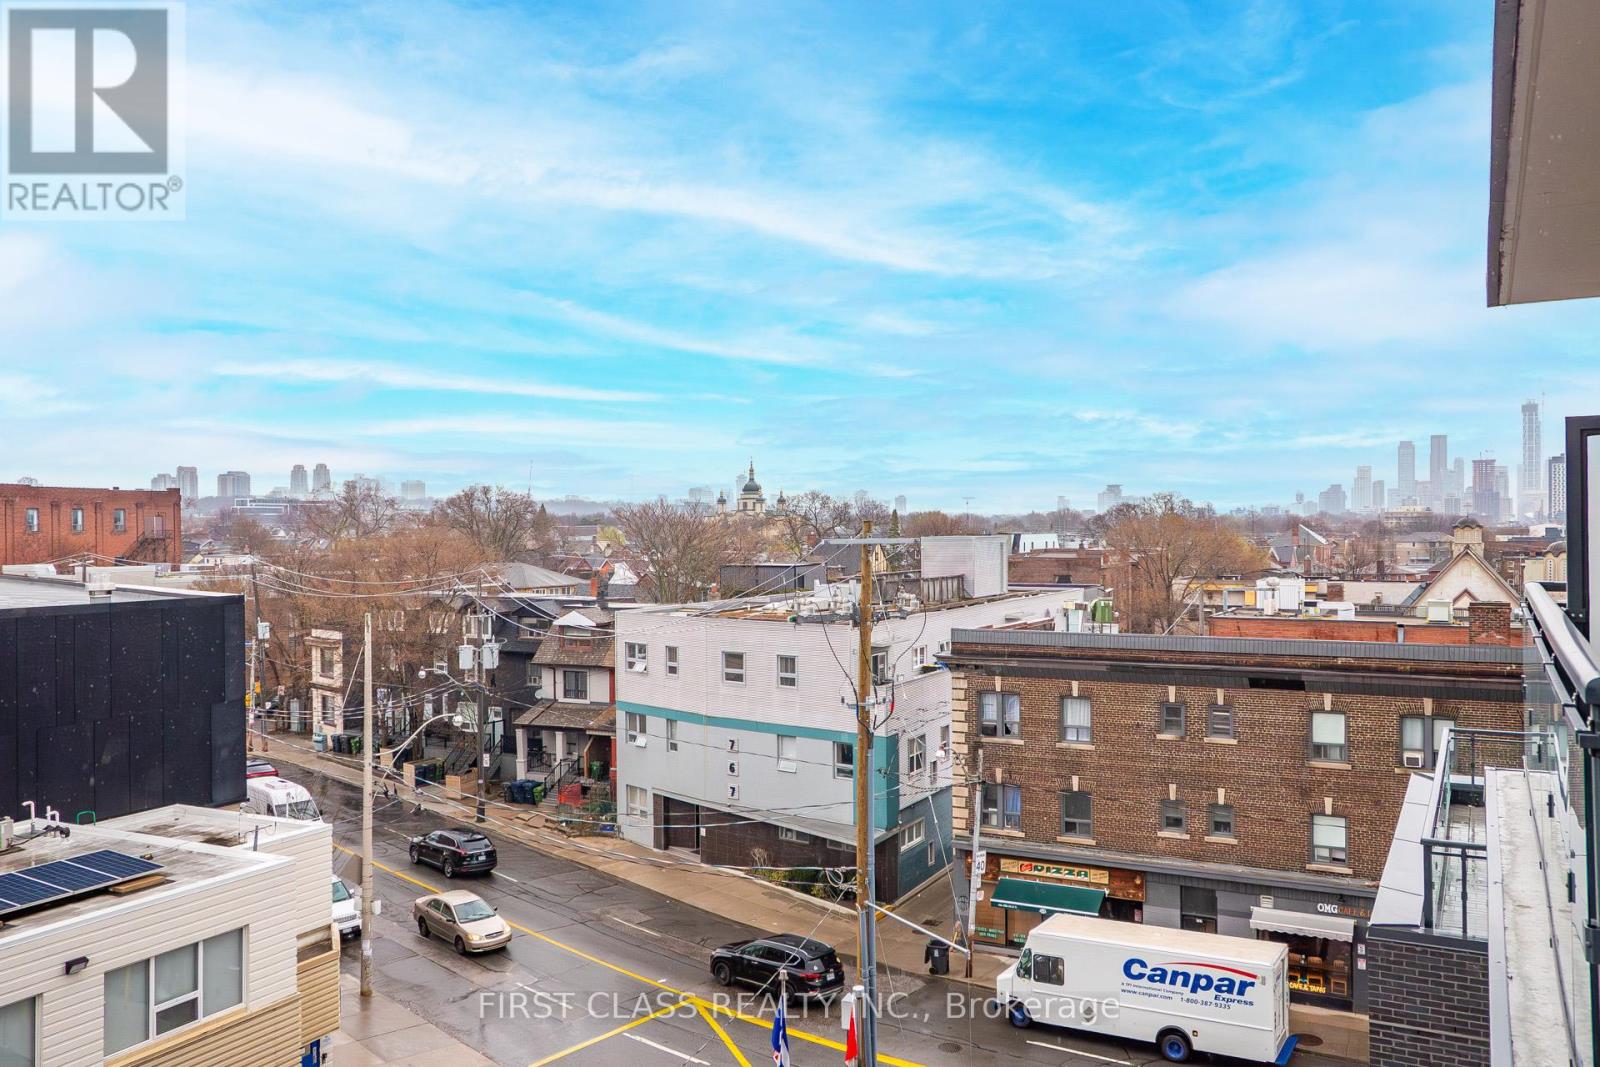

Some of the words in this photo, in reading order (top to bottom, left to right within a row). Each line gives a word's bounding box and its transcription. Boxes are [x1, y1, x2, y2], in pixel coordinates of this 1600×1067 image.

[976, 860, 985, 871] 40
[1033, 864, 1089, 879] PIZZA
[1317, 903, 1338, 914] OMG
[1122, 958, 1256, 997] Canpar
[1121, 988, 1173, 1000] www.canpar.com
[1214, 994, 1254, 1007] Express
[1180, 997, 1231, 1010] 1-800-387-9335
